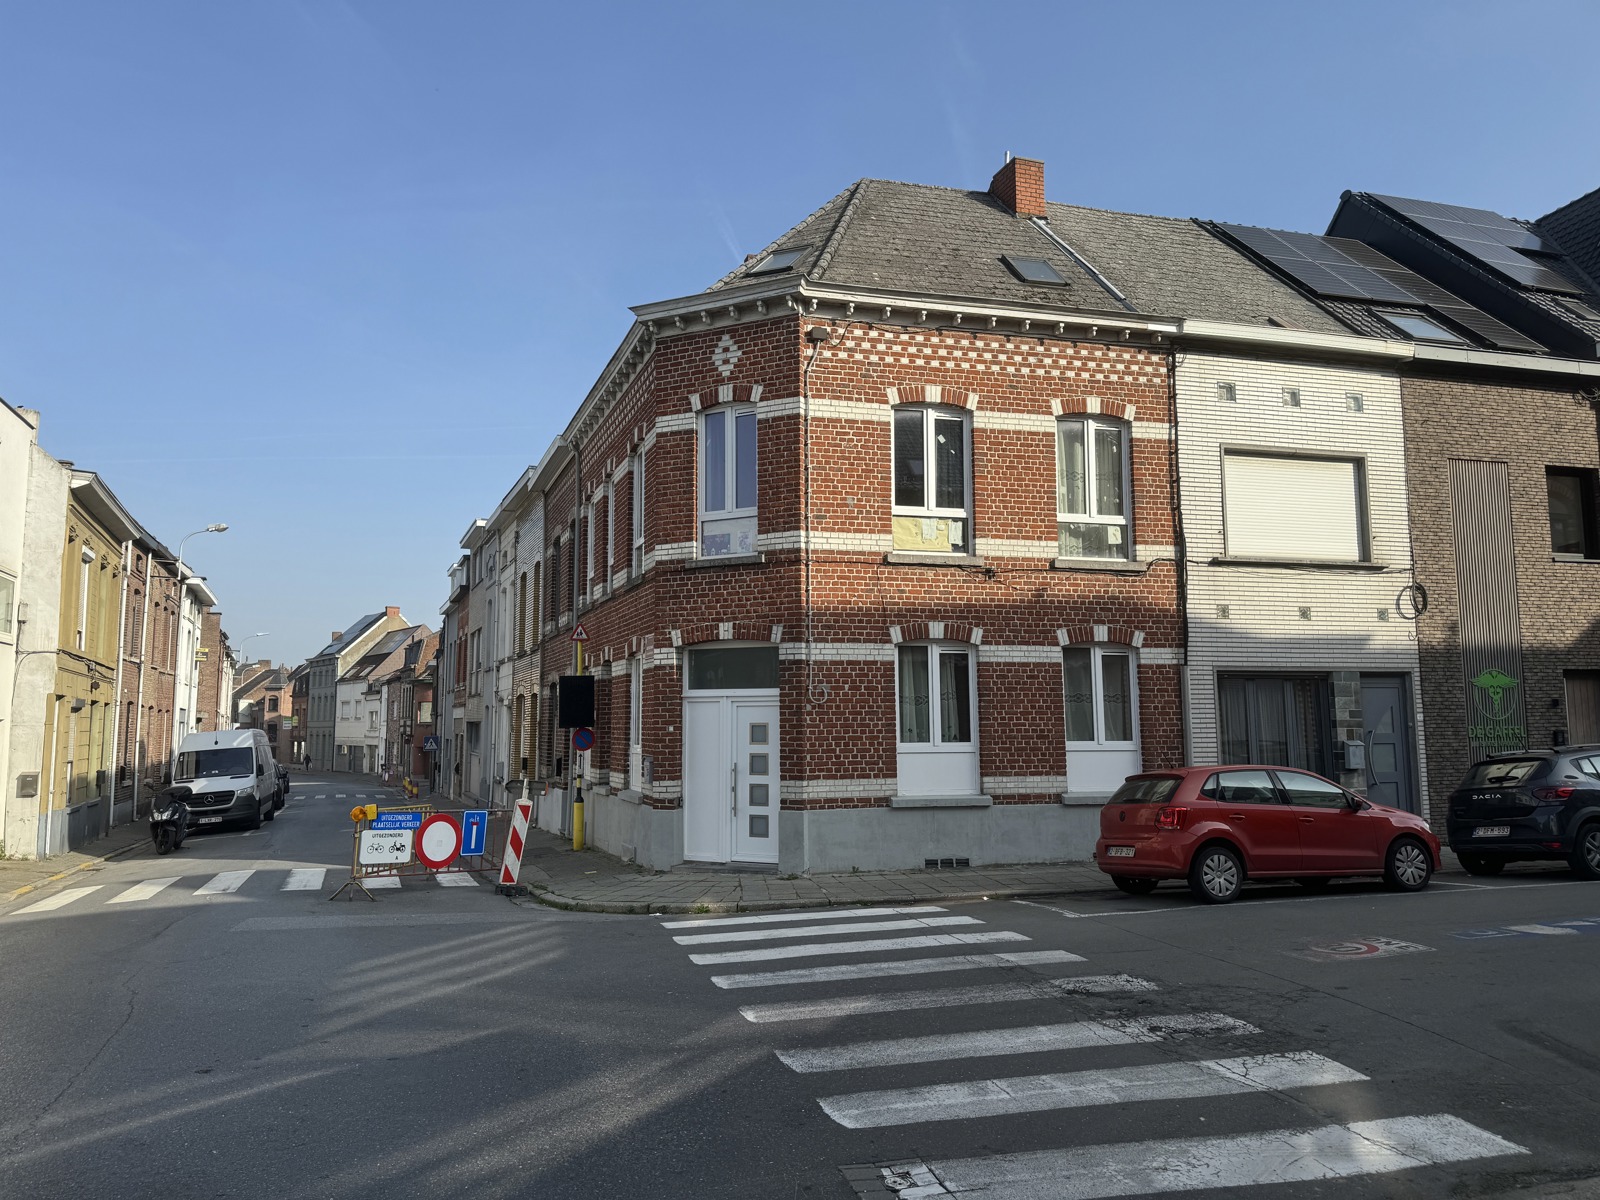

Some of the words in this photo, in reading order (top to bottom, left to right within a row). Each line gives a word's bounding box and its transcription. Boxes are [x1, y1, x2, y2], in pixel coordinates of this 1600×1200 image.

[1469, 725, 1484, 737] DE
[1486, 725, 1527, 737] GAFFEL
[1361, 937, 1419, 950] ONE
